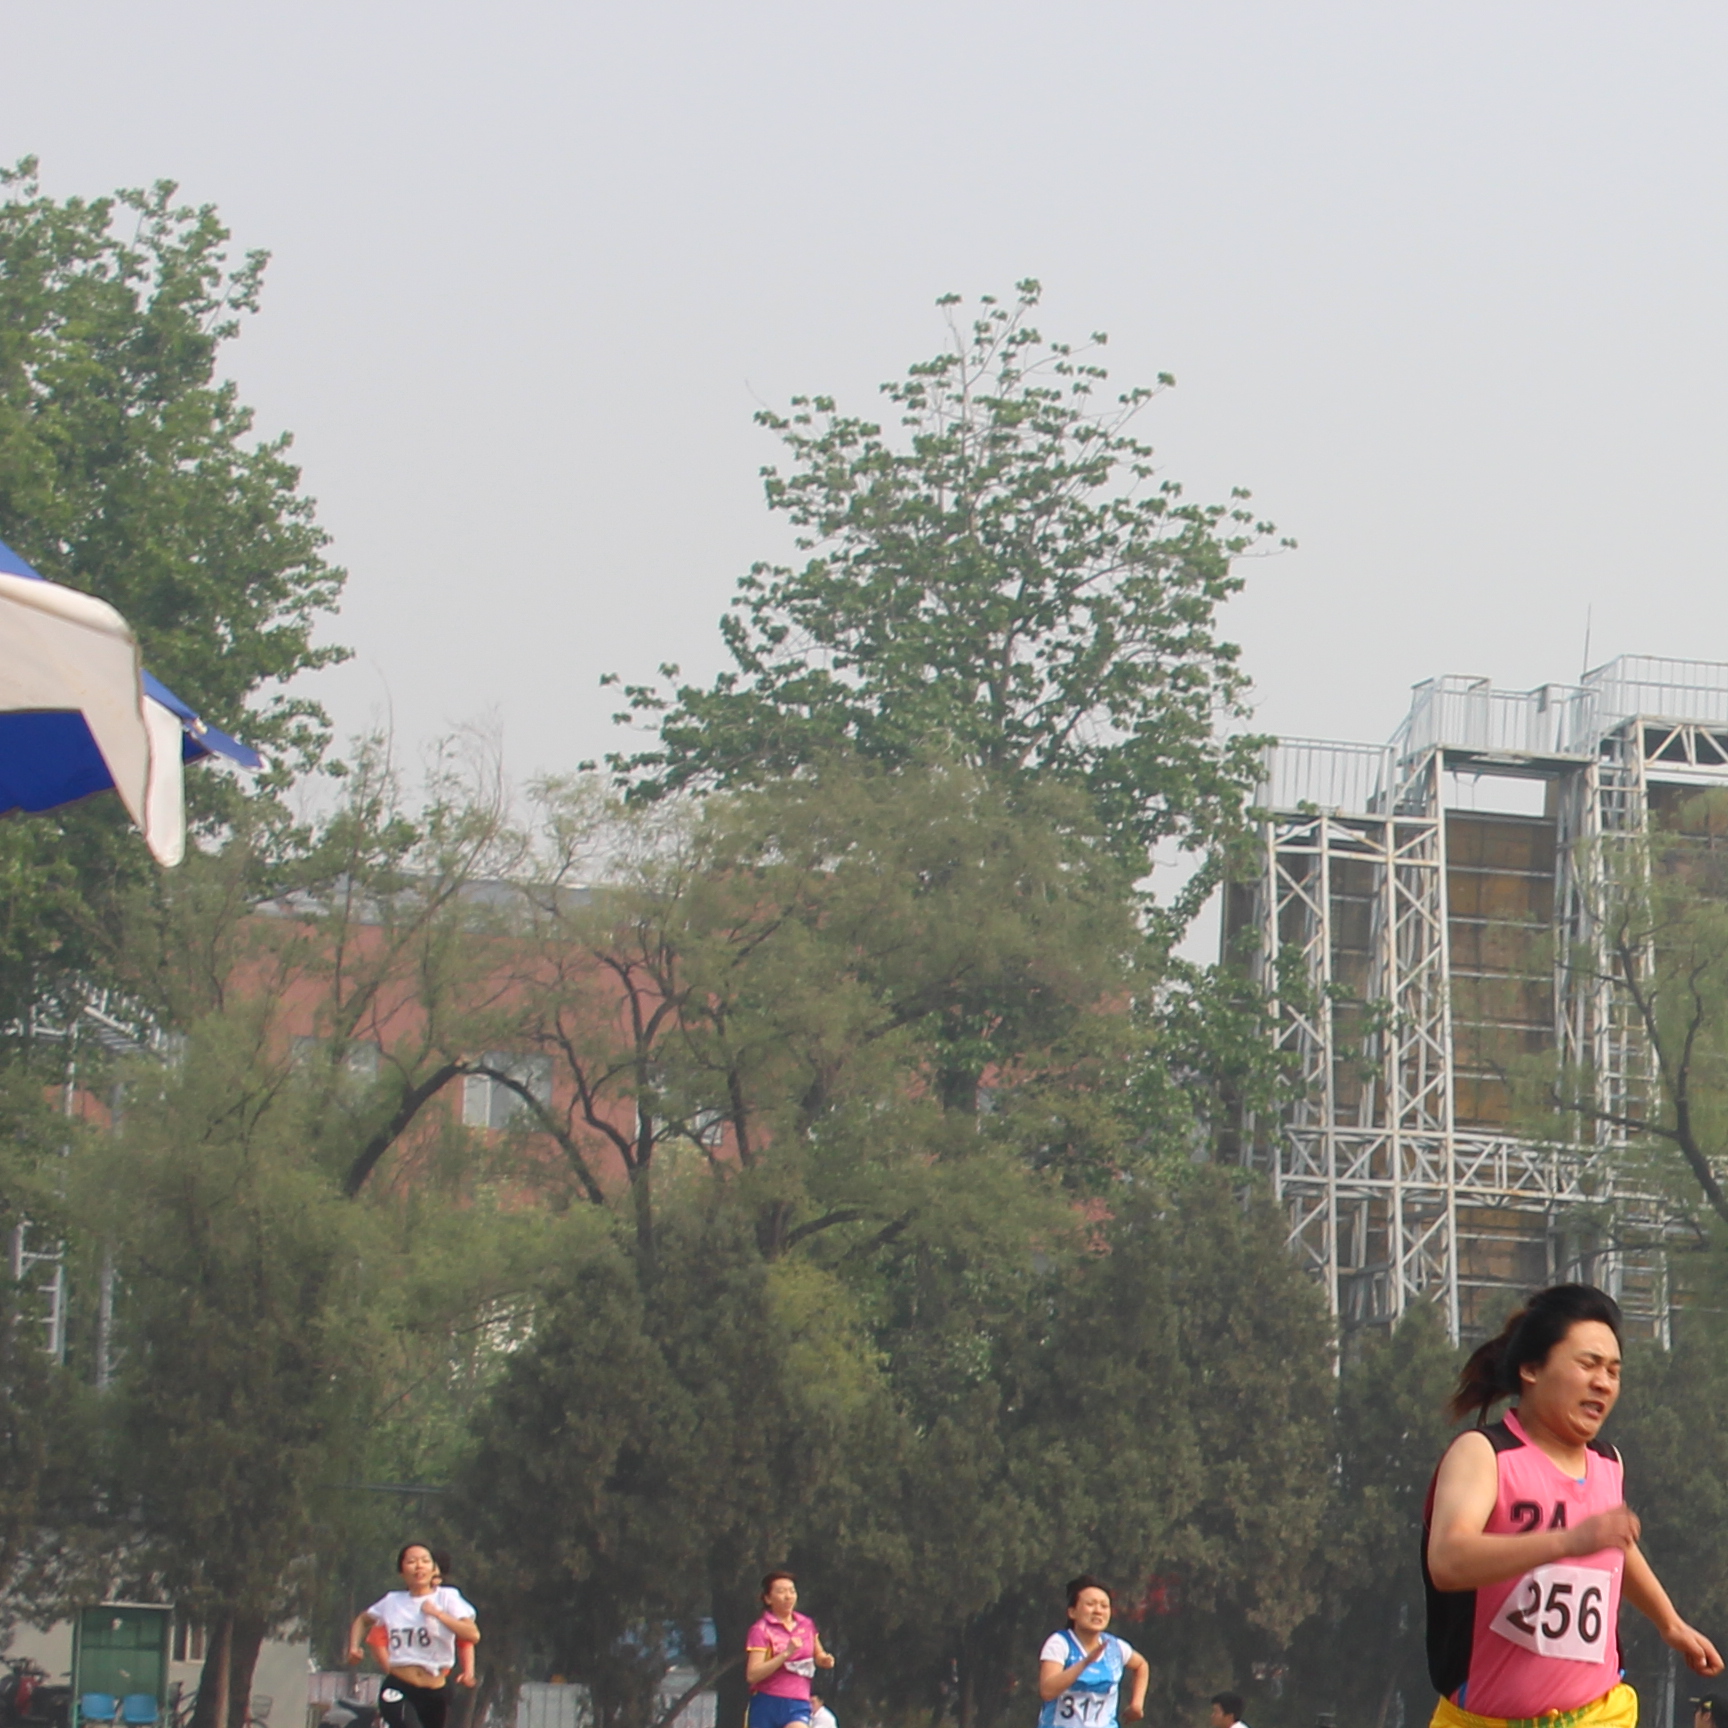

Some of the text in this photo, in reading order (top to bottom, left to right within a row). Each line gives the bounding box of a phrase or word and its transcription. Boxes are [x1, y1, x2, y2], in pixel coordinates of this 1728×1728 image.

[1506, 1580, 1602, 1643] 256
[390, 1627, 431, 1650] 578
[1061, 1695, 1105, 1722] 317
